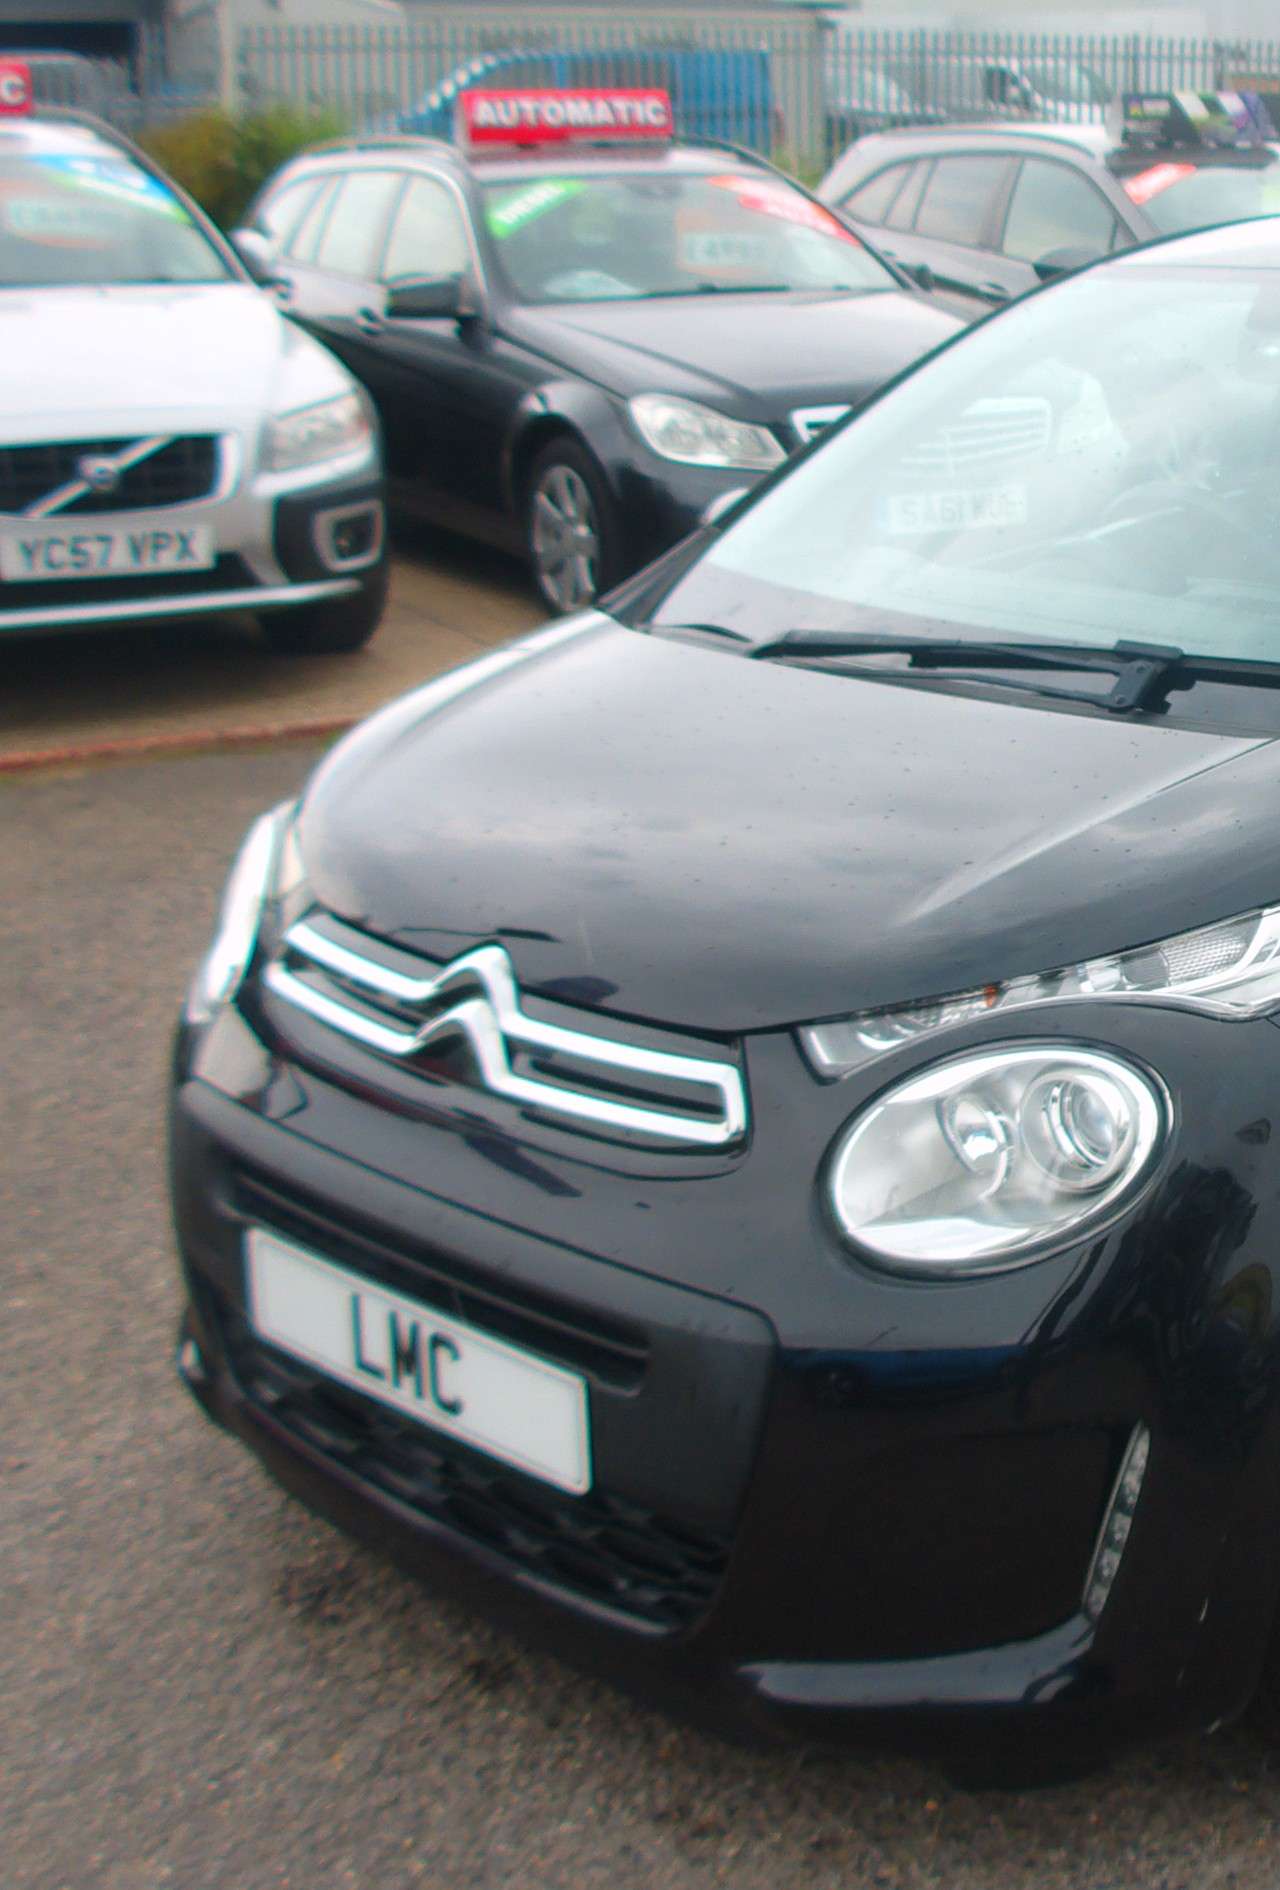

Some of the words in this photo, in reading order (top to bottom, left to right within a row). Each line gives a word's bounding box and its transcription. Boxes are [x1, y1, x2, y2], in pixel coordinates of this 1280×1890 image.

[475, 97, 667, 127] AUTOMATIC
[18, 534, 113, 570] YC57
[126, 528, 196, 568] VPX
[351, 1293, 463, 1416] LMC
